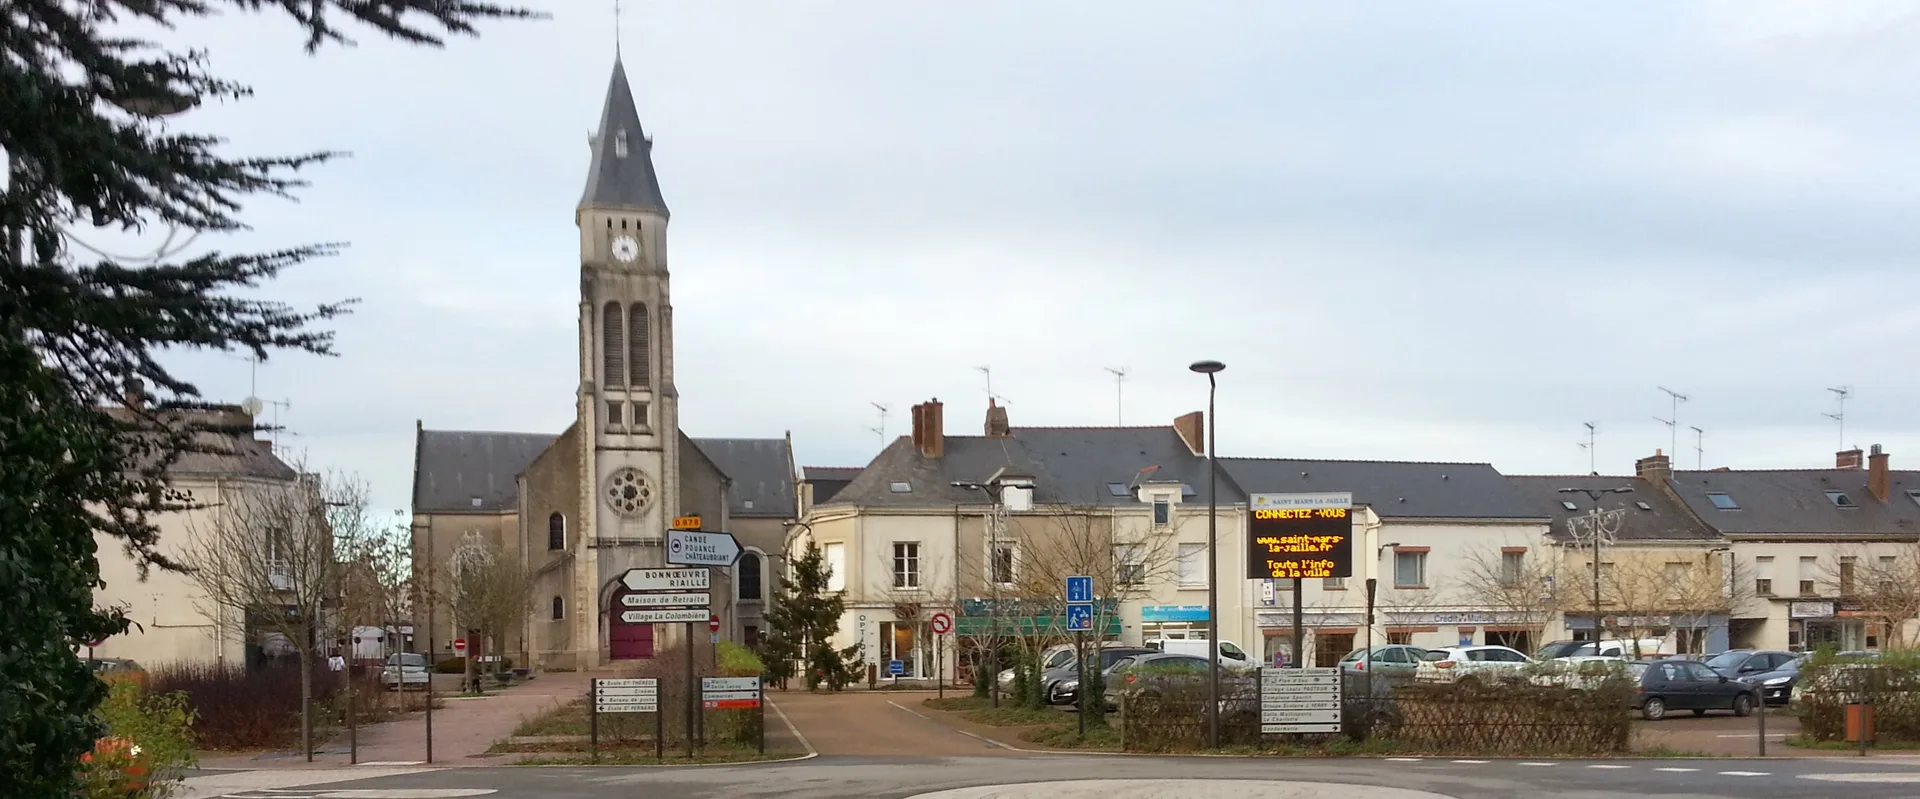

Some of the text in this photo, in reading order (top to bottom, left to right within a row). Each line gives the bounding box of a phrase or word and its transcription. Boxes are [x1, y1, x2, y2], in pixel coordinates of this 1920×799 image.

[1255, 509, 1311, 519] CONNECTEZ
[1267, 559, 1334, 569] Toute l'info
[645, 570, 707, 578] BONNŒUVRE
[1272, 568, 1330, 578] de la ville
[670, 578, 707, 587] RIAILLÉ
[628, 596, 656, 604] Maison
[672, 595, 705, 603] Retraite
[628, 612, 706, 621] Village La Colombière
